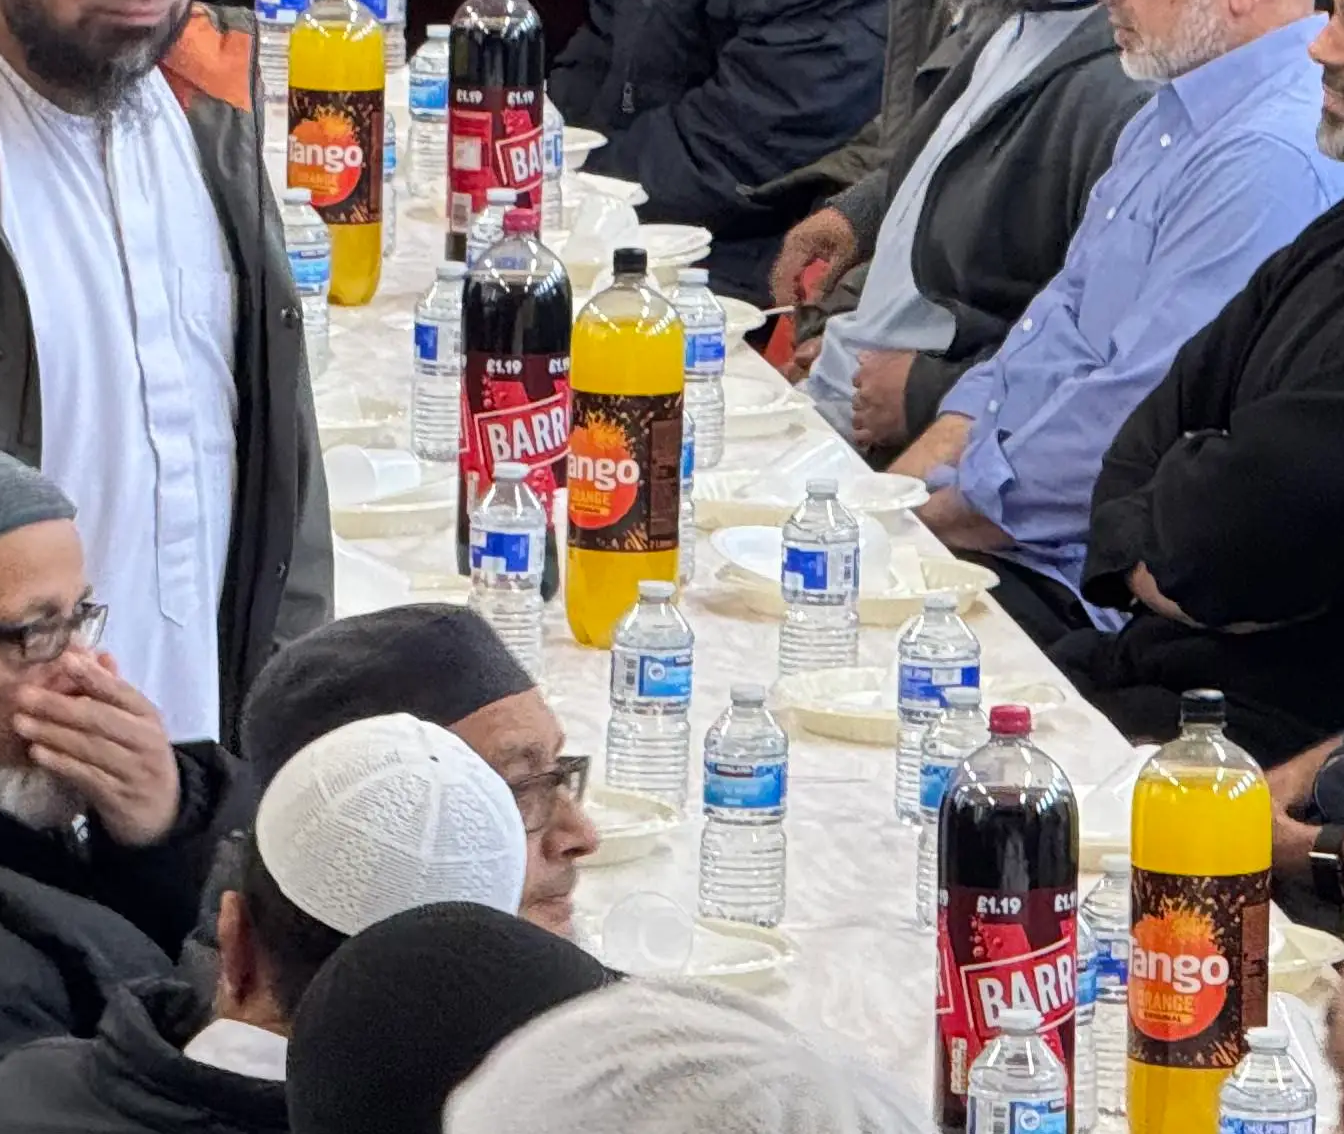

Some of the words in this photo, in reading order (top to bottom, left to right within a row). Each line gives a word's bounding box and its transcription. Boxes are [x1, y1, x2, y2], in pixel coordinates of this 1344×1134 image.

[486, 358, 523, 374] £1.19
[487, 407, 567, 463] BARR
[567, 453, 640, 491] ango
[976, 895, 1022, 915] £1.19
[977, 954, 1074, 1028] BARR
